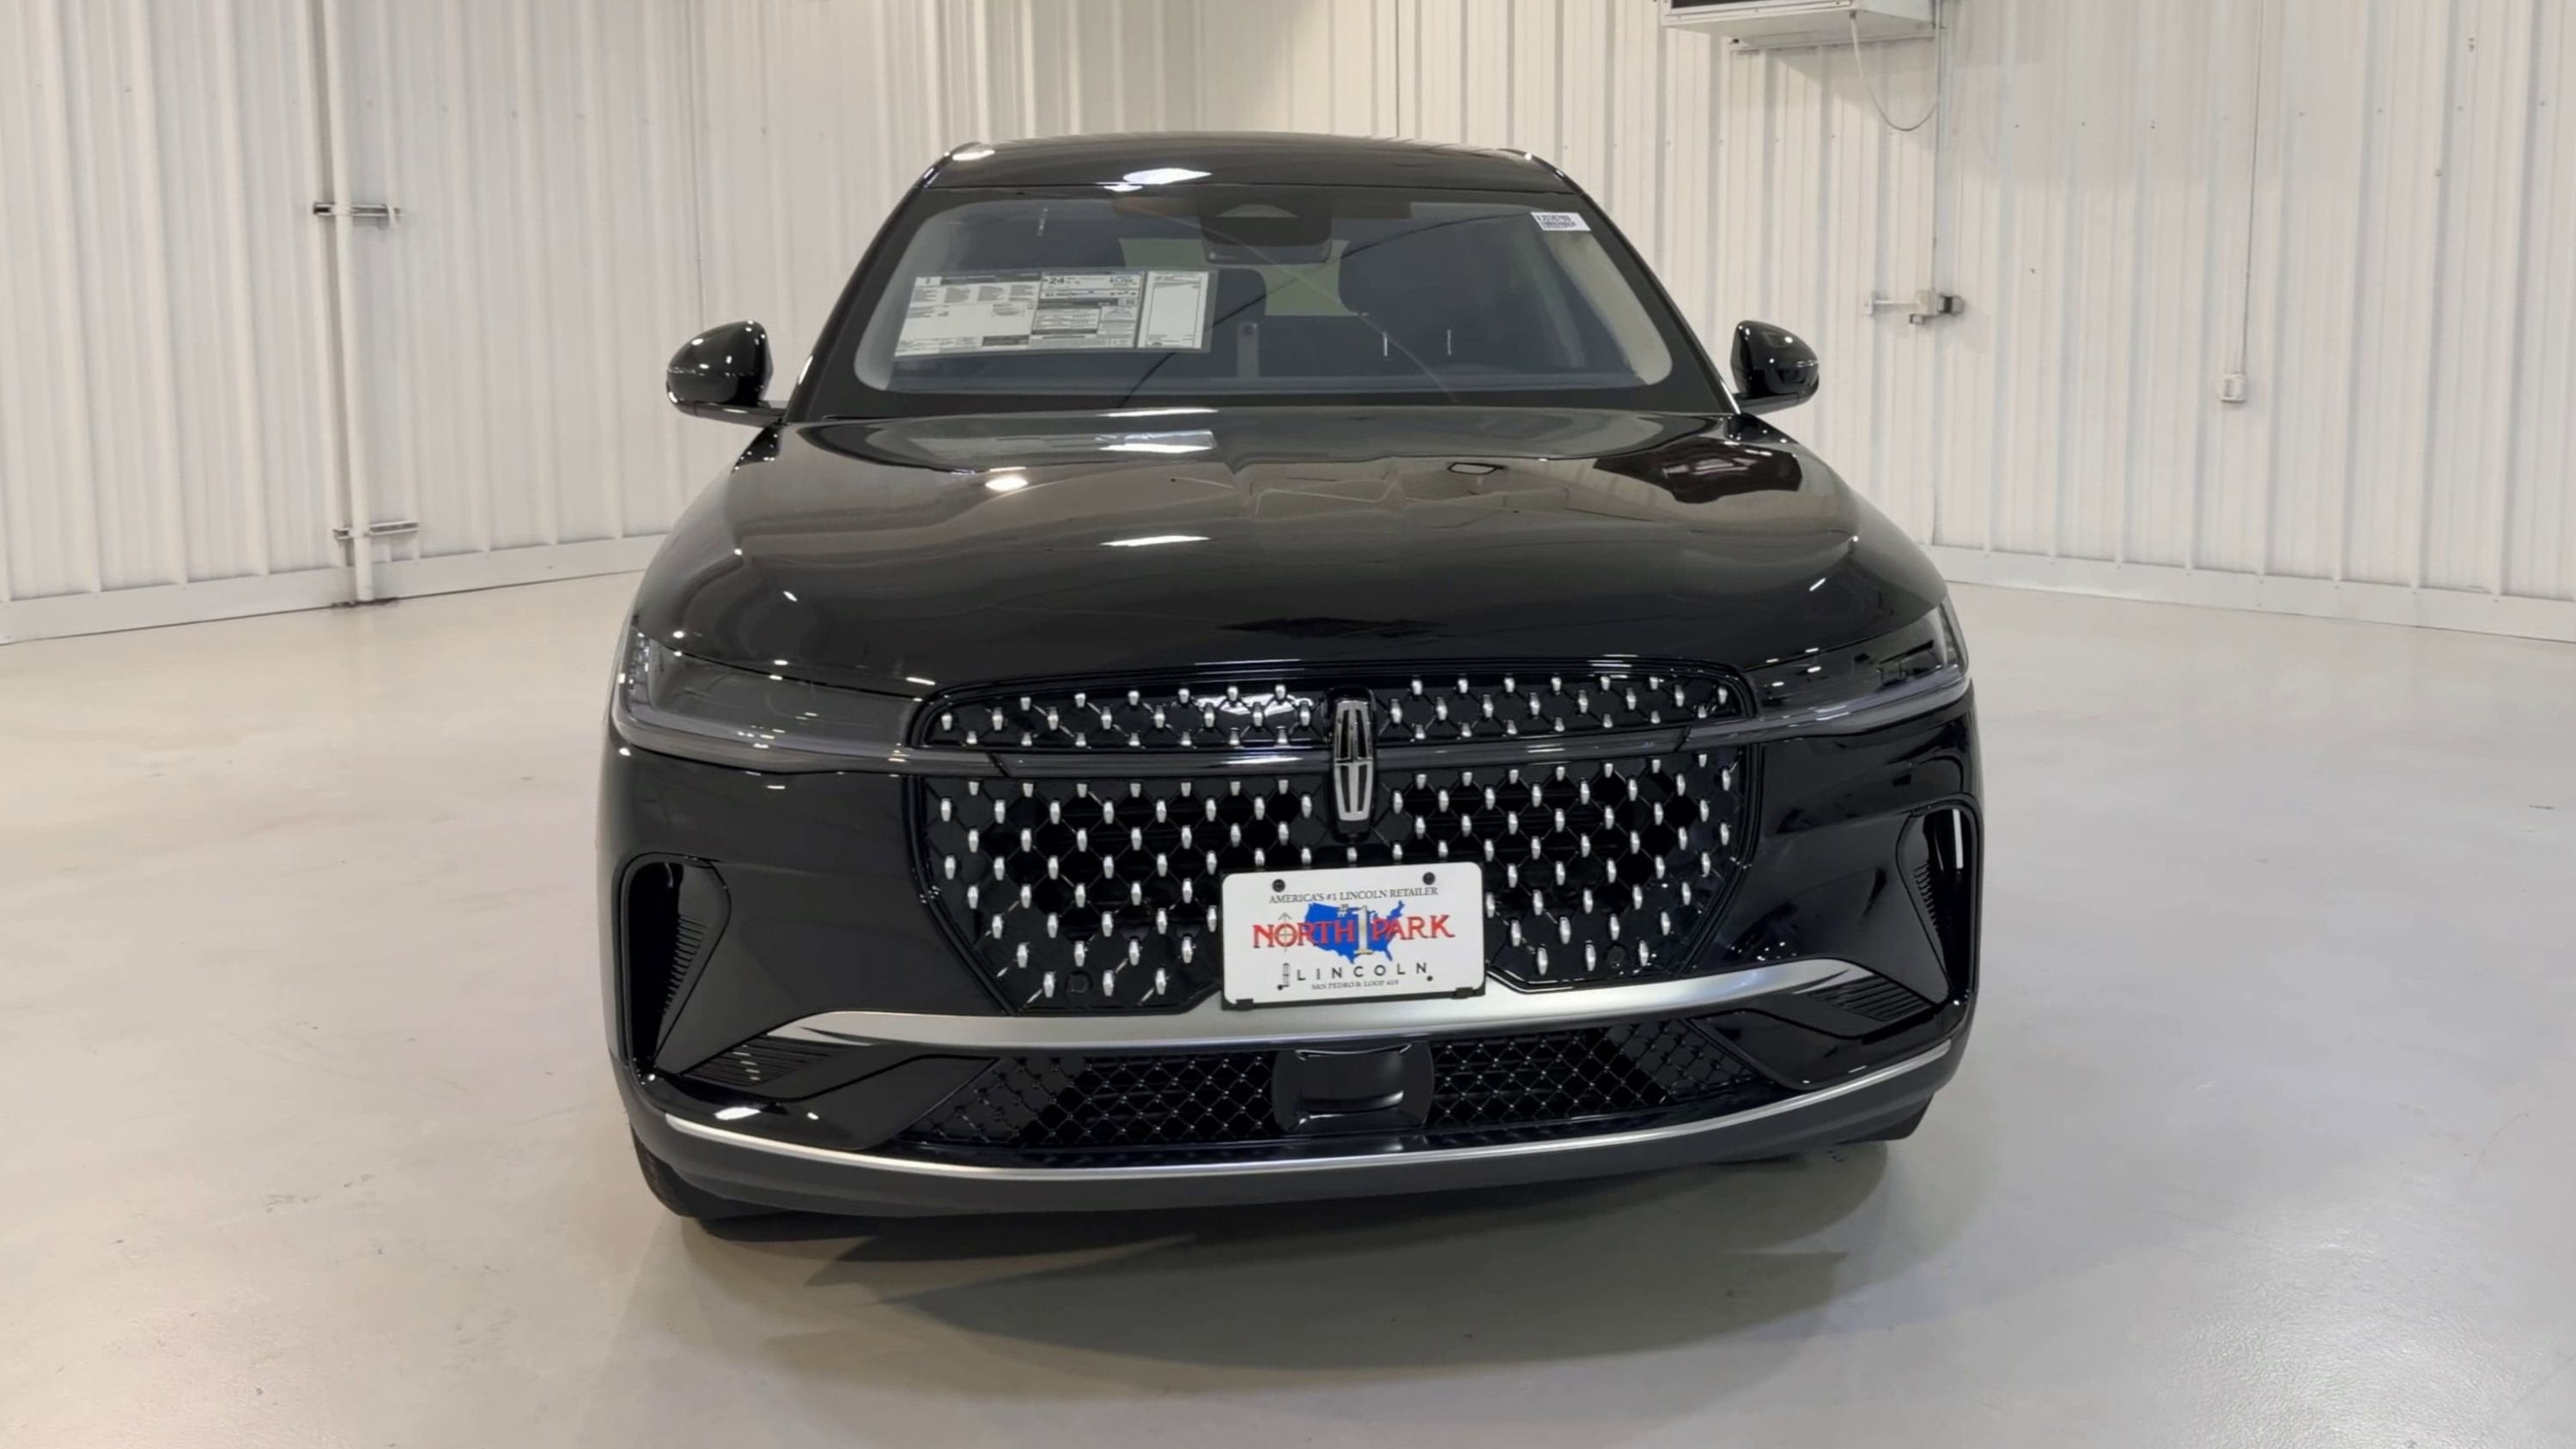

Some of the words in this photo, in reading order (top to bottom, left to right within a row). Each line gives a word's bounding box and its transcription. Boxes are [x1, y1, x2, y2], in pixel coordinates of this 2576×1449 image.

[1269, 893, 1324, 904] AMERICA'S
[1340, 889, 1388, 900] LINCOLN
[1389, 887, 1438, 898] RETAILER
[1253, 920, 1354, 949] NORTH
[1372, 914, 1455, 940] PARK
[1297, 961, 1427, 980] LINCOLN
